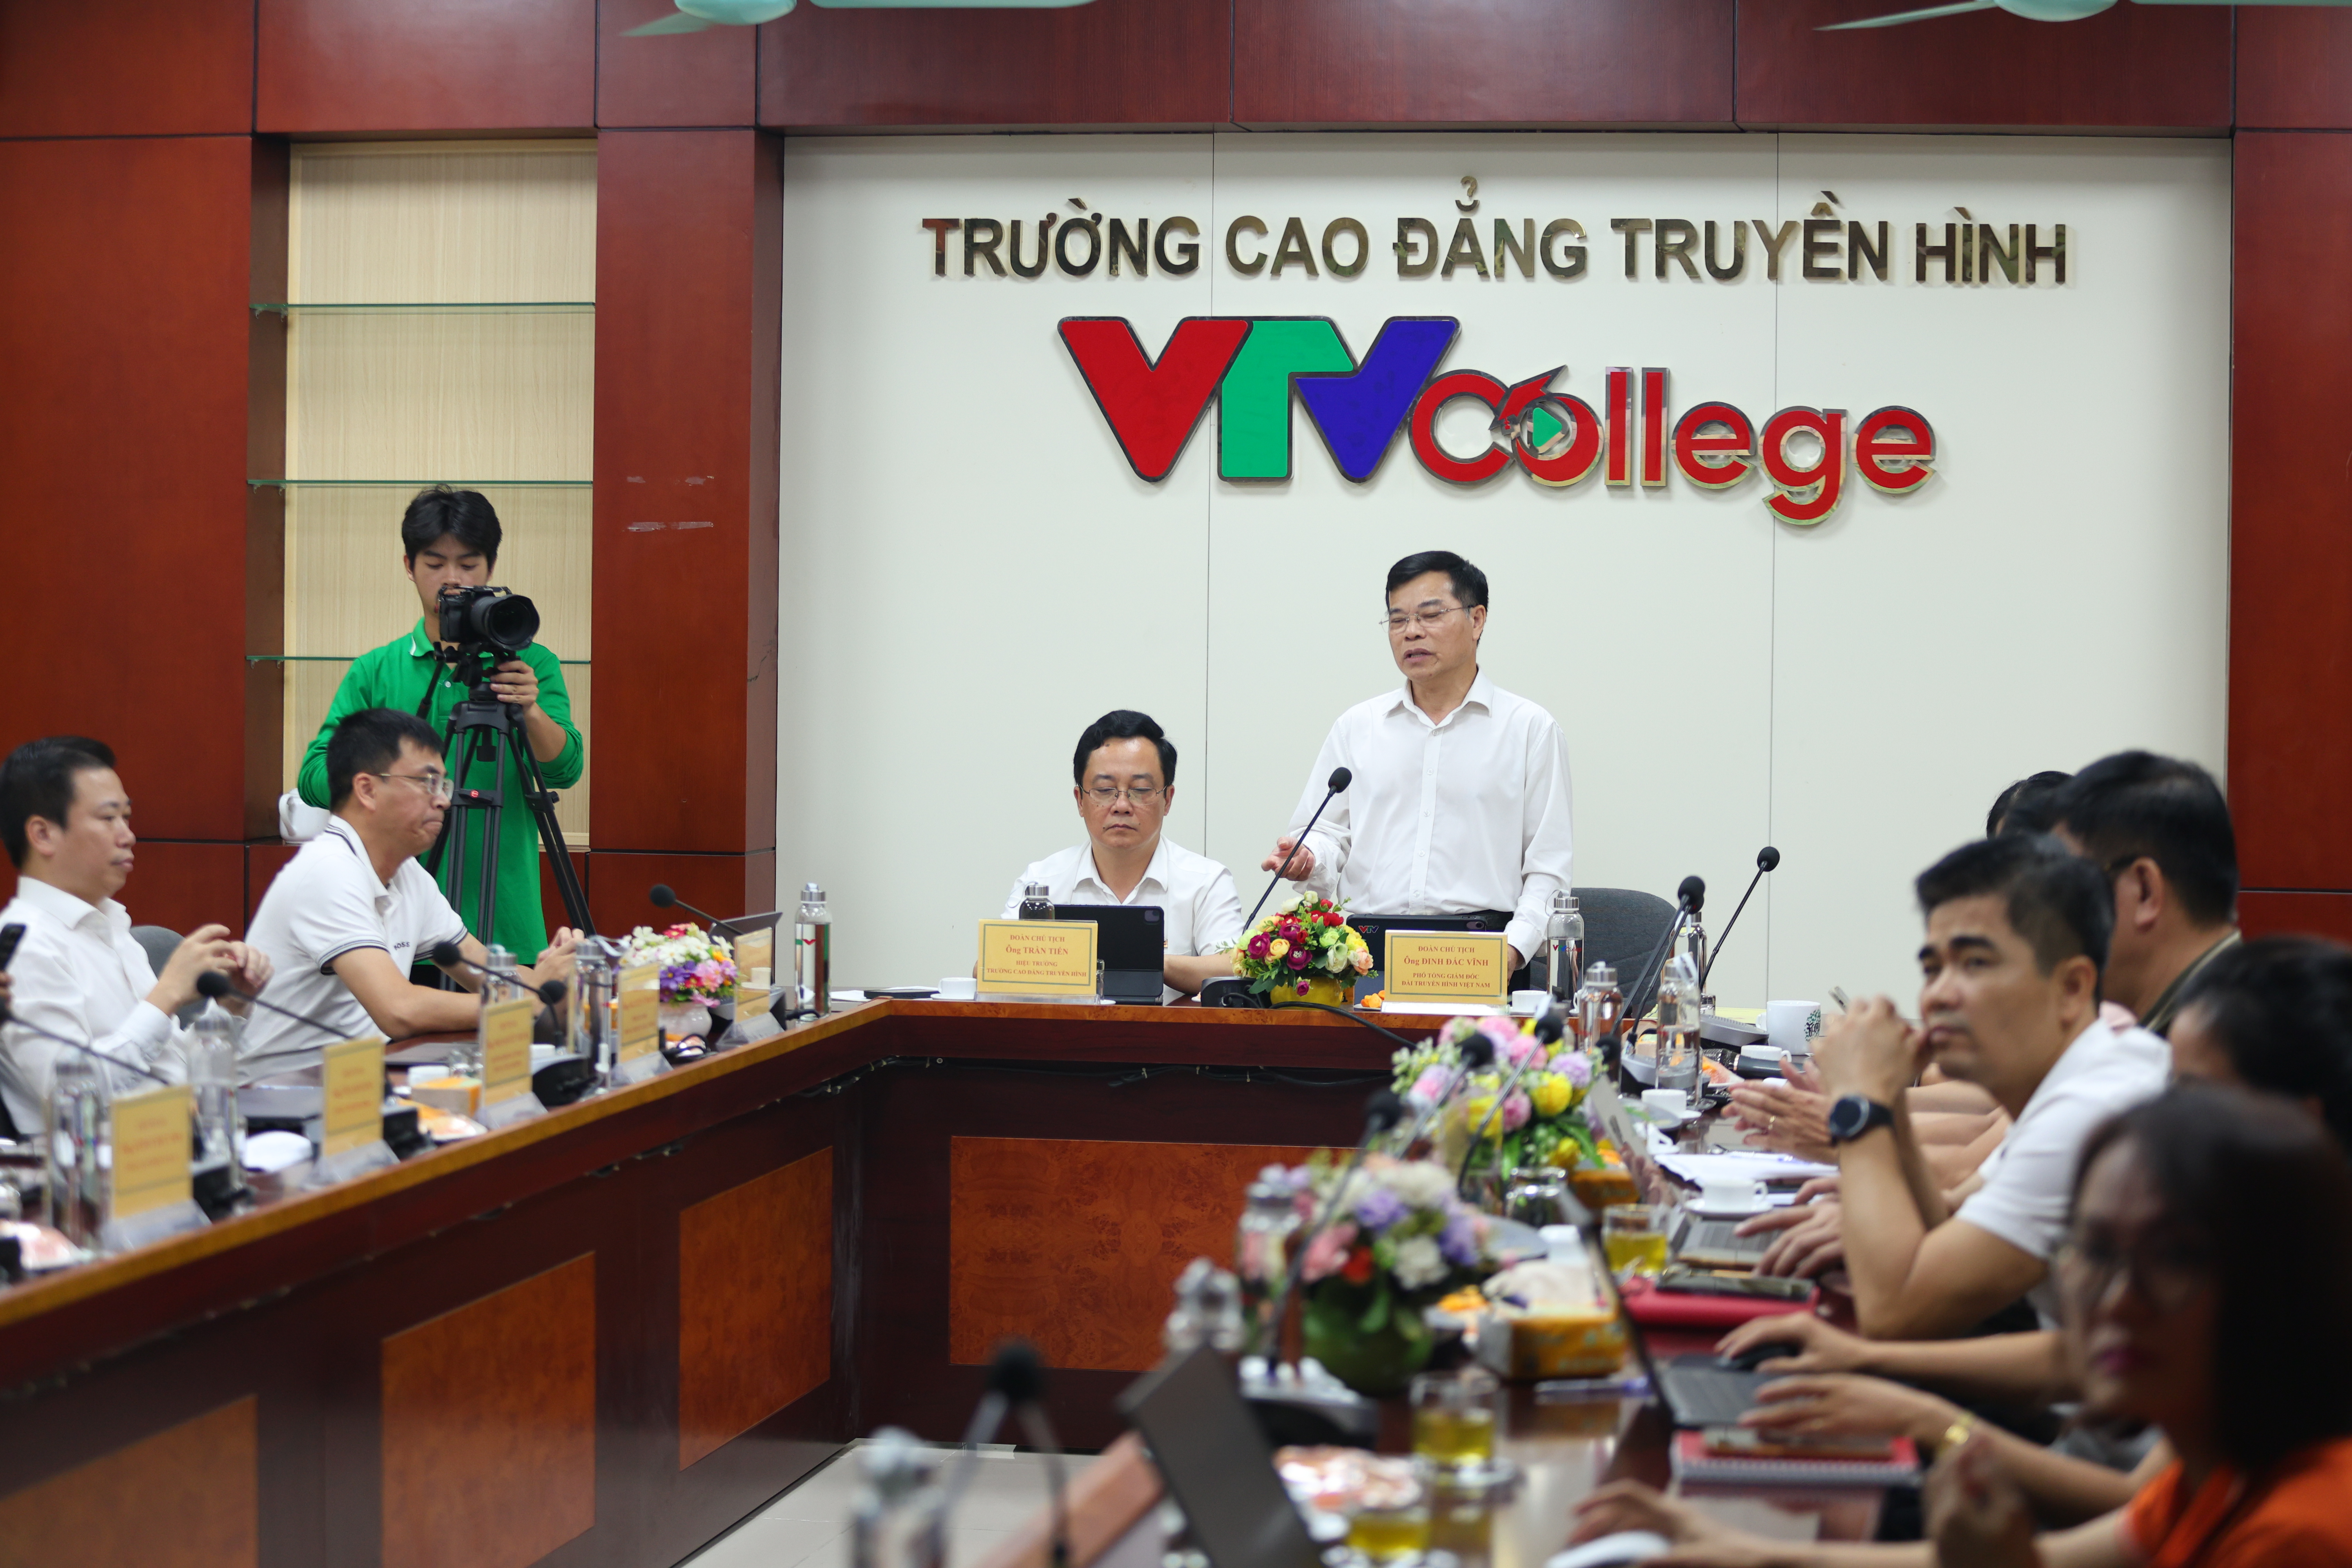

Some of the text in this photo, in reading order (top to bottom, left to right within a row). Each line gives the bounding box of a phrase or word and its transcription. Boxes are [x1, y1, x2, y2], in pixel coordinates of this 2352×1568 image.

[922, 176, 2066, 284] TRƯỜNG CAO ĐẲNG TRUYỀN HÌNH
[394, 942, 410, 951] BOSS
[1006, 944, 1021, 955] Ông
[1404, 956, 1419, 965] Ông
